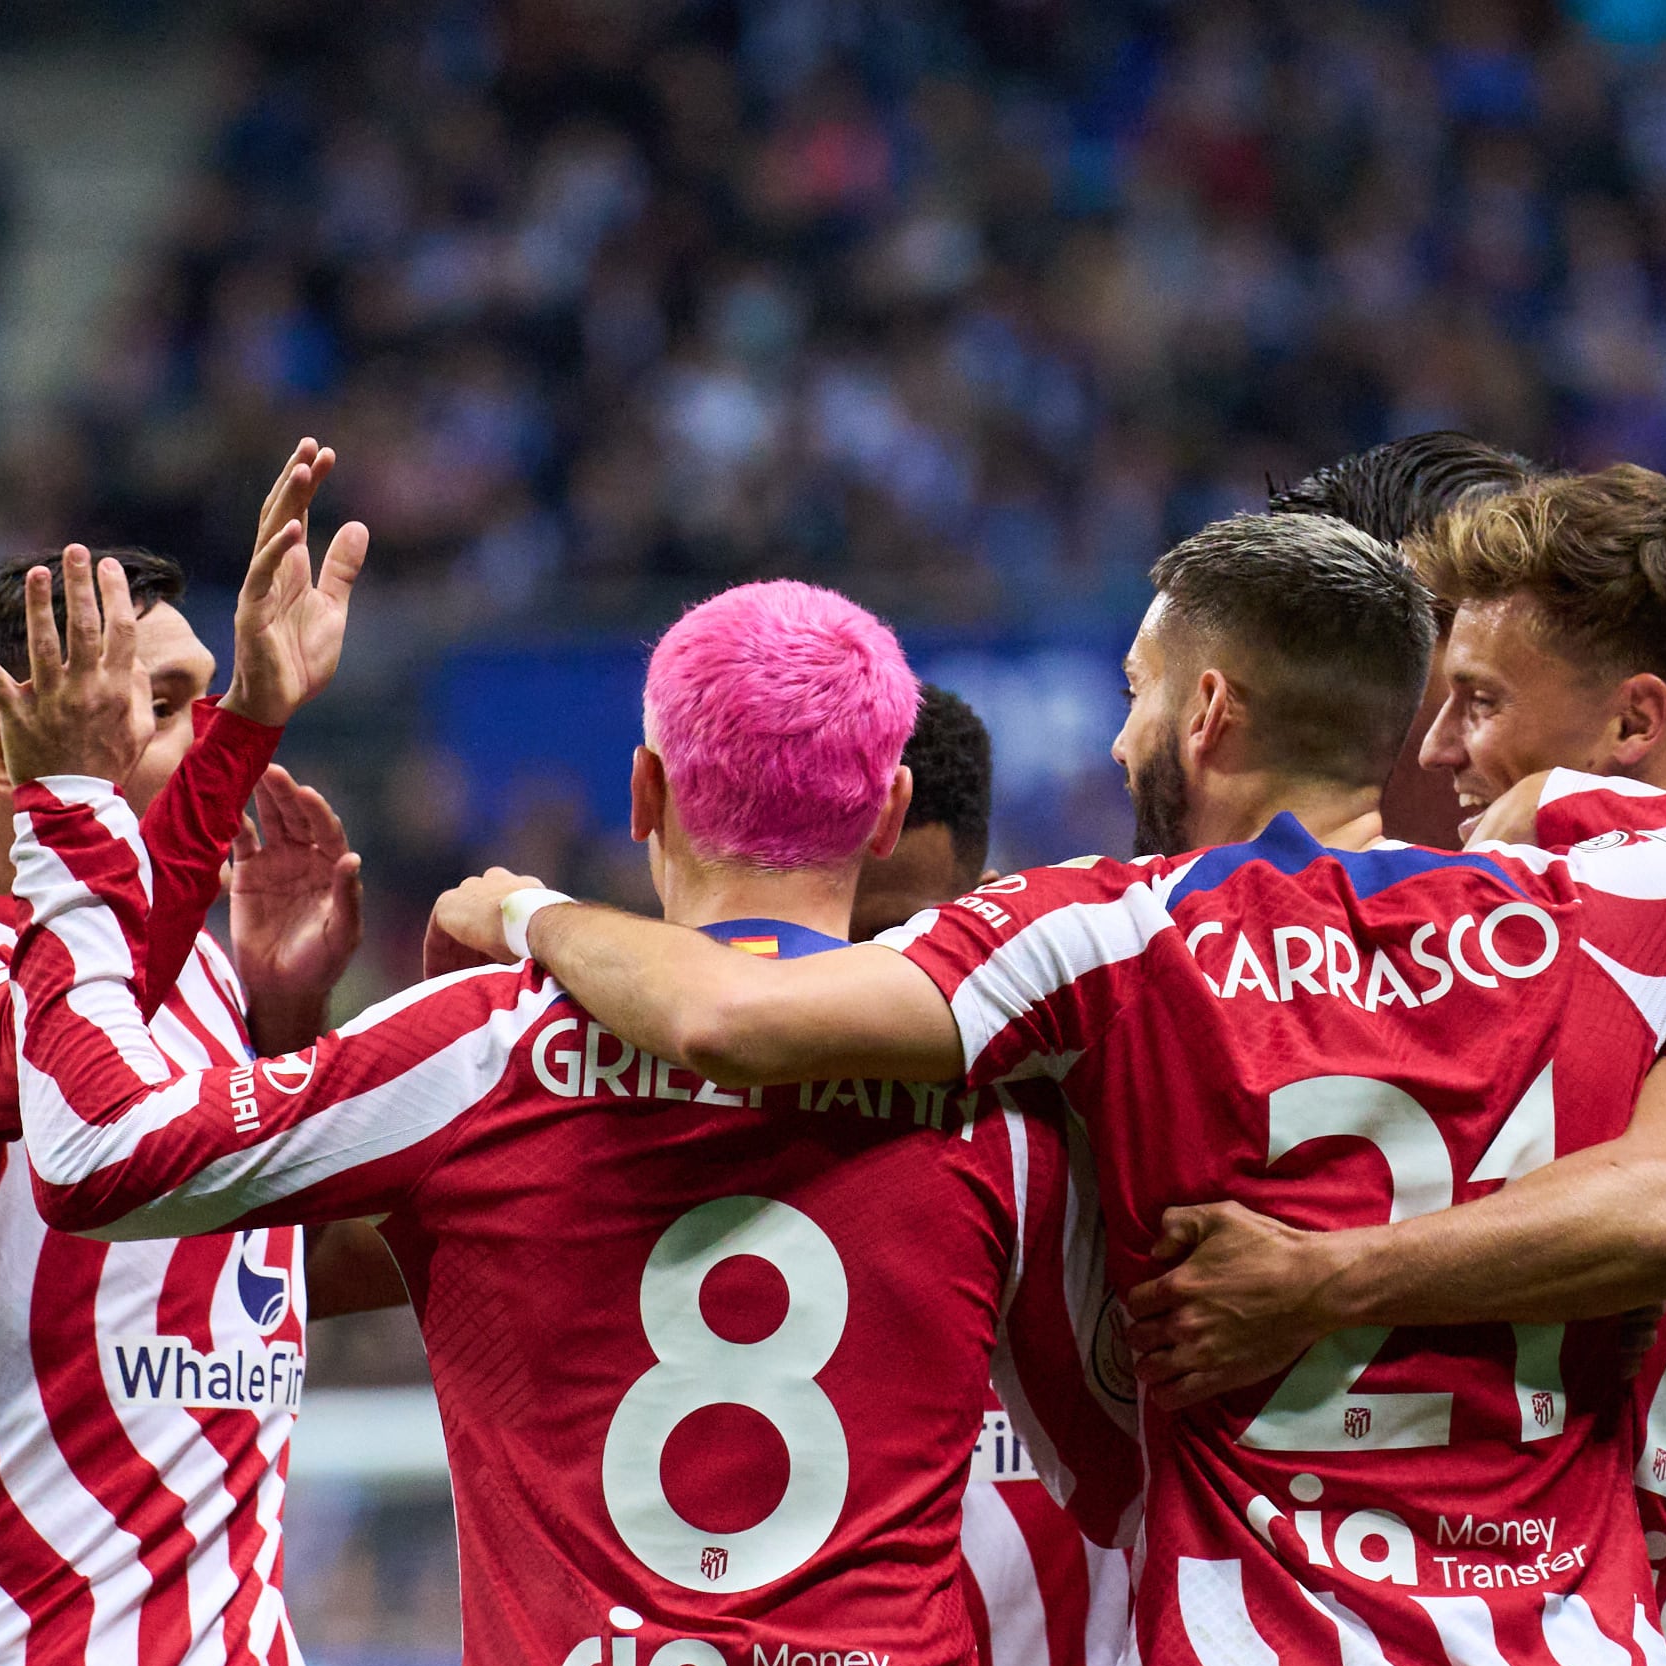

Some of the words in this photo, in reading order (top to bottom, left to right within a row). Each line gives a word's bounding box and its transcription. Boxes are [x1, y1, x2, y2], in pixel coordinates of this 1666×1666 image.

[1185, 902, 1560, 1013] CARRASCO
[1233, 1057, 1567, 1452] 21
[602, 1195, 849, 1594] 8
[1433, 1544, 1588, 1588] Transfer
[1436, 1514, 1557, 1553] Money
